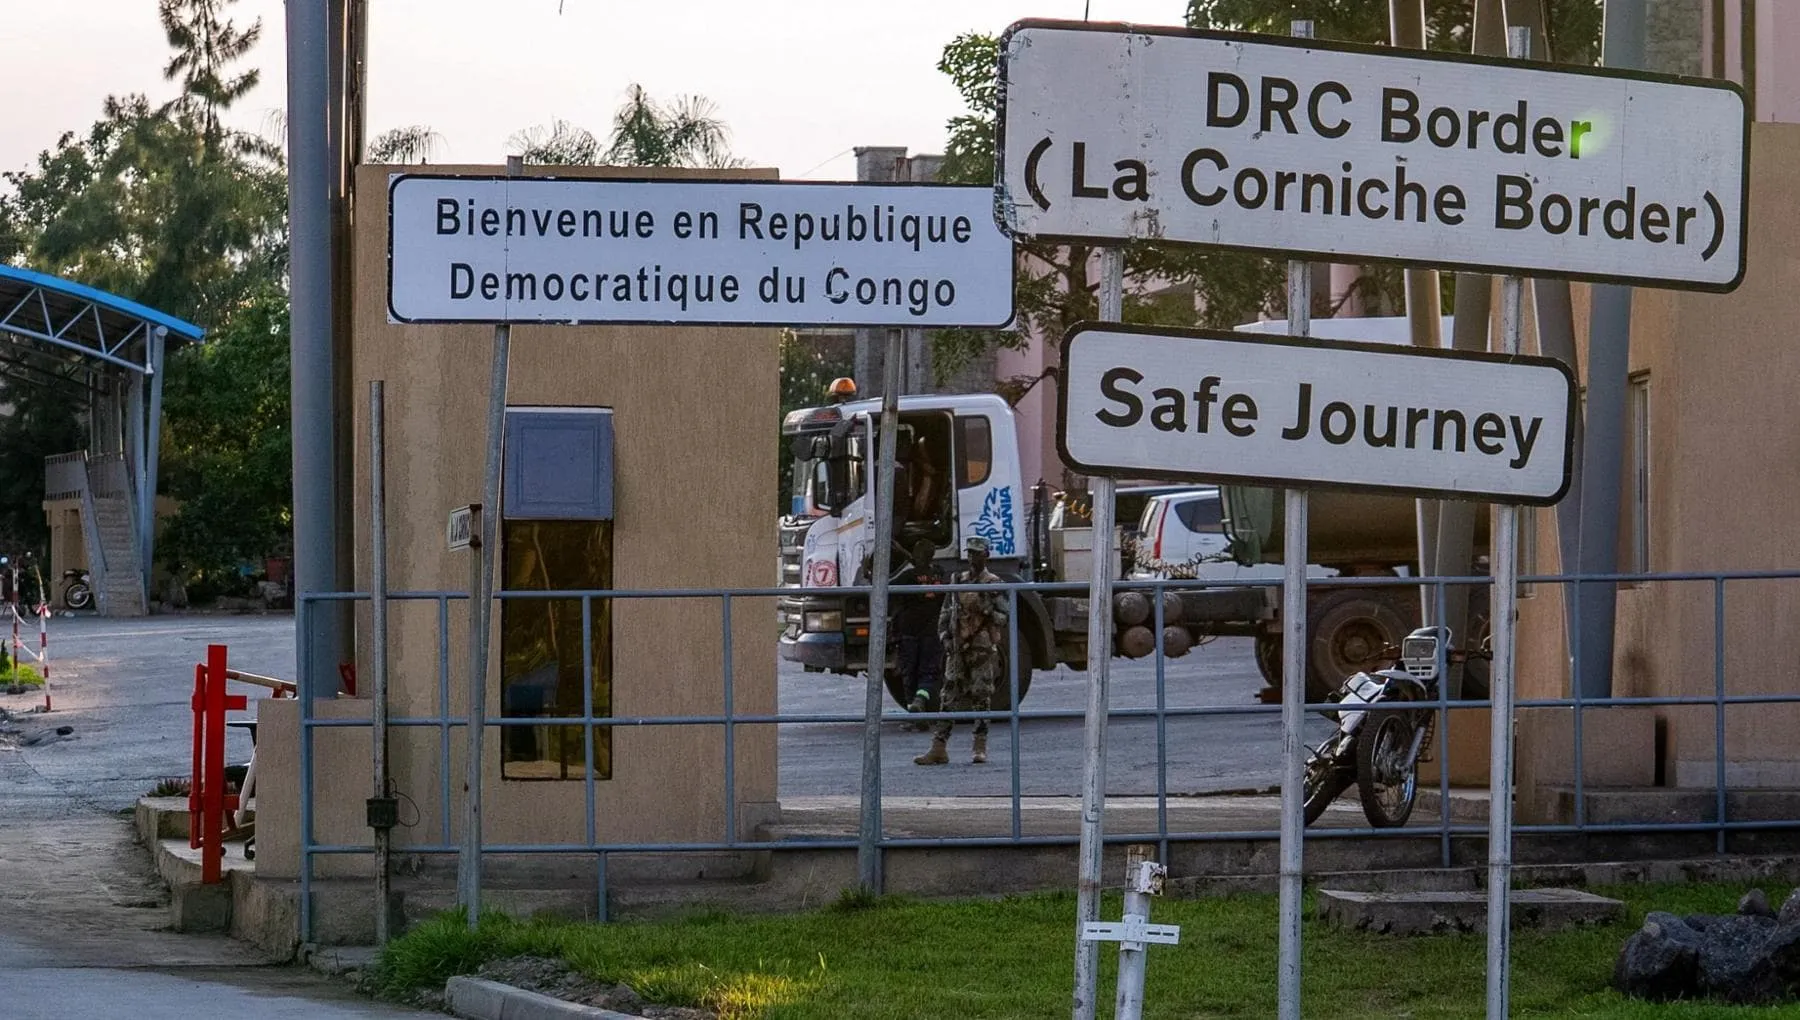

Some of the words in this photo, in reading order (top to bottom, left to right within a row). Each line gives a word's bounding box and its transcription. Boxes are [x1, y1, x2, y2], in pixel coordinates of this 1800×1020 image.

[1206, 71, 1353, 130] DRC
[1380, 87, 1592, 160] Border
[436, 198, 655, 238] Bienvenue
[673, 211, 719, 240] en
[739, 202, 972, 252] Republique
[1180, 147, 1467, 226] Corniche
[1494, 173, 1725, 262] Border)
[450, 262, 739, 312] Democratique
[758, 266, 805, 304] du
[825, 266, 955, 317] Congo
[1094, 366, 1258, 438] Safe
[1281, 382, 1544, 470] Journey
[1000, 486, 1016, 555] SCANIA
